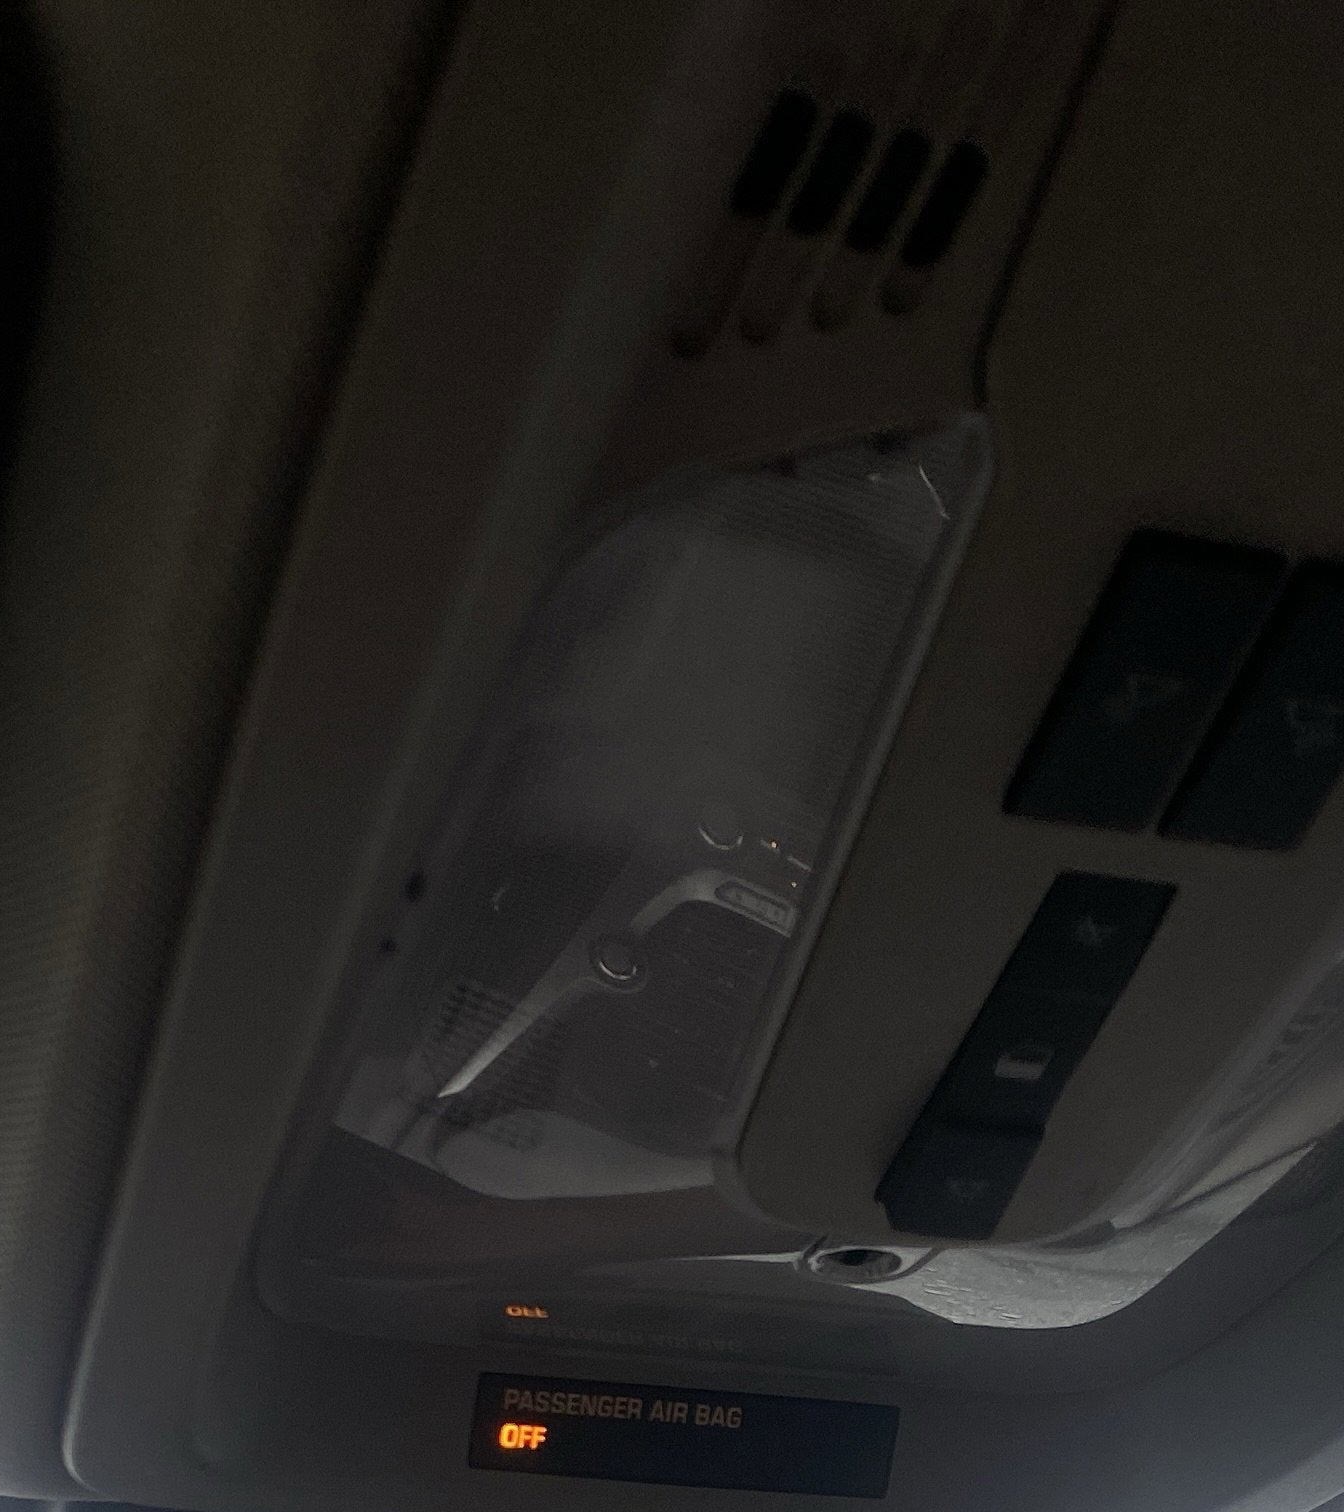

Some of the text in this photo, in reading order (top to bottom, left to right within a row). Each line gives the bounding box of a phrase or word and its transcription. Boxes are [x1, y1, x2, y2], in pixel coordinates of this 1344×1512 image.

[503, 1387, 744, 1429] PASSENGER AIR BAG
[498, 1423, 548, 1450] OFF
